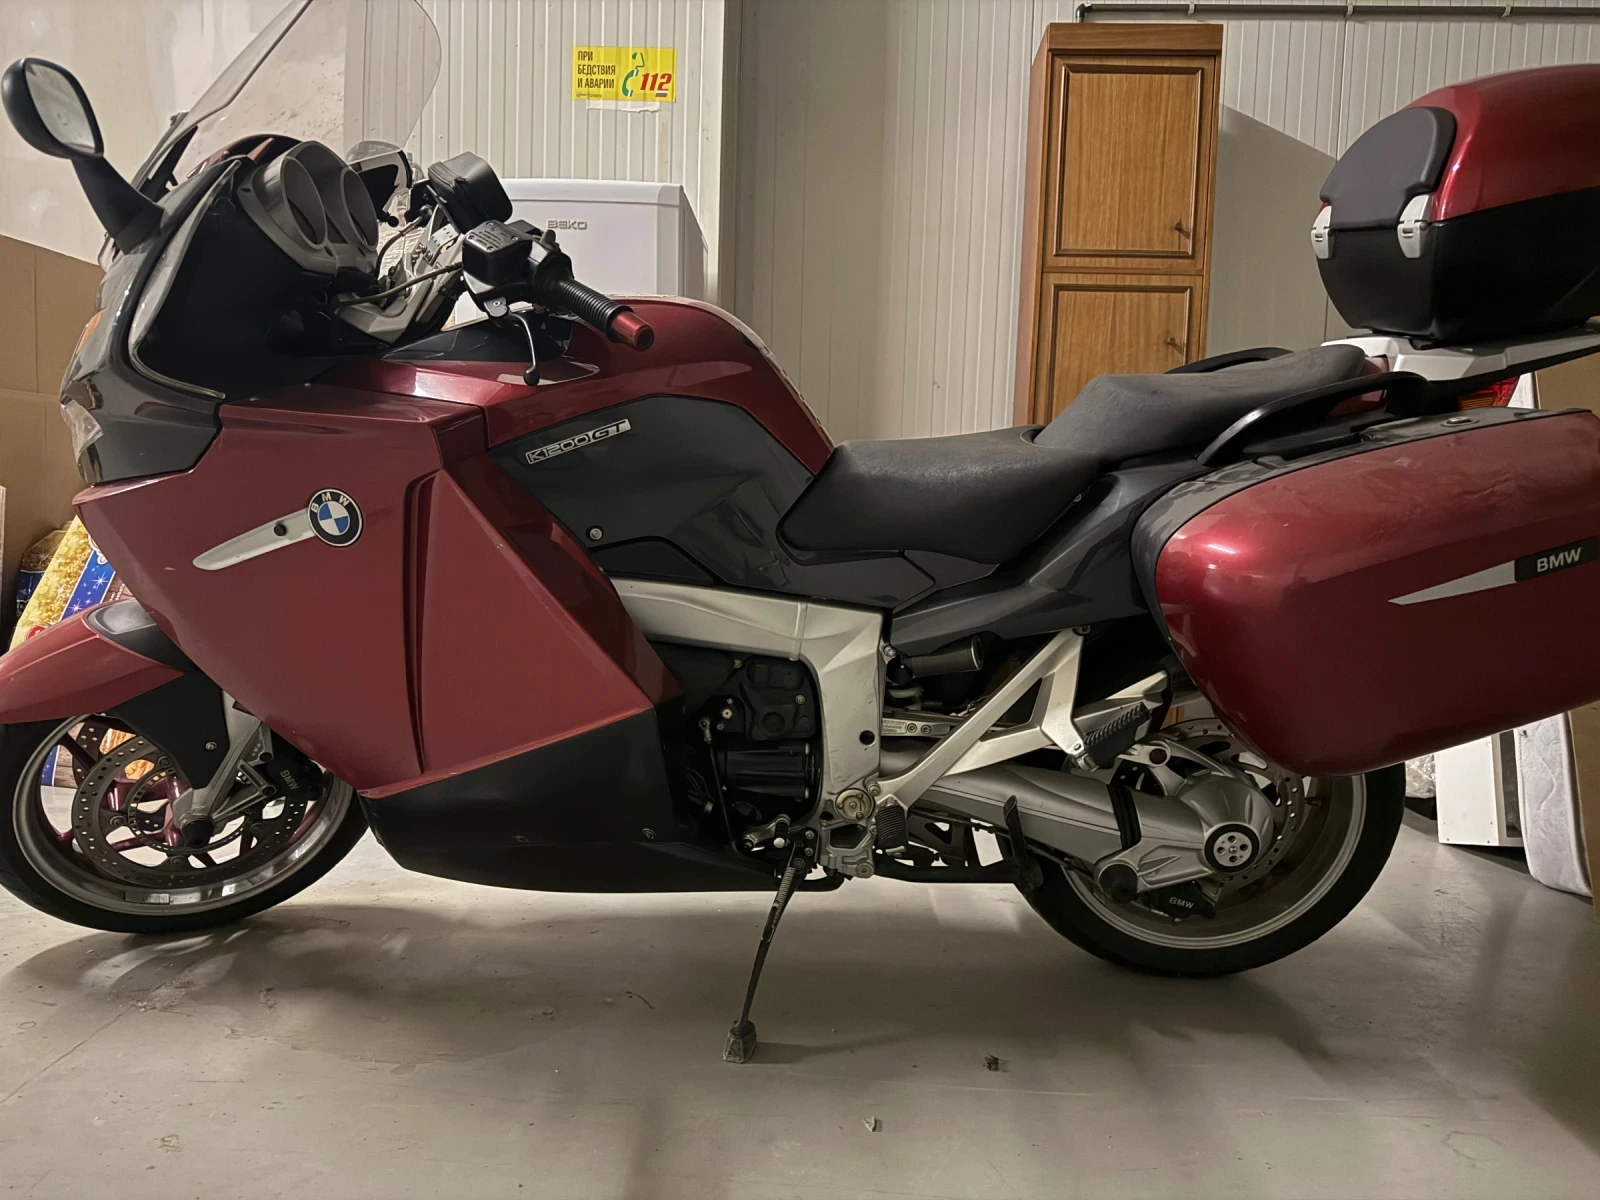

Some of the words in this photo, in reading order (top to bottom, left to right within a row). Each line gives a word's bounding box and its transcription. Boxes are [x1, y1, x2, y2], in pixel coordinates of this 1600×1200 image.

[577, 50, 593, 61] ПРИ
[577, 63, 616, 76] БЕДСТВИЯ
[577, 77, 583, 88] И
[584, 77, 615, 89] АВАРИИ
[640, 72, 673, 91] 112
[547, 220, 588, 230] BEKO
[310, 491, 351, 513] BMW
[1536, 546, 1582, 573] BMW
[280, 769, 300, 790] BMW
[1169, 896, 1195, 909] BMW
